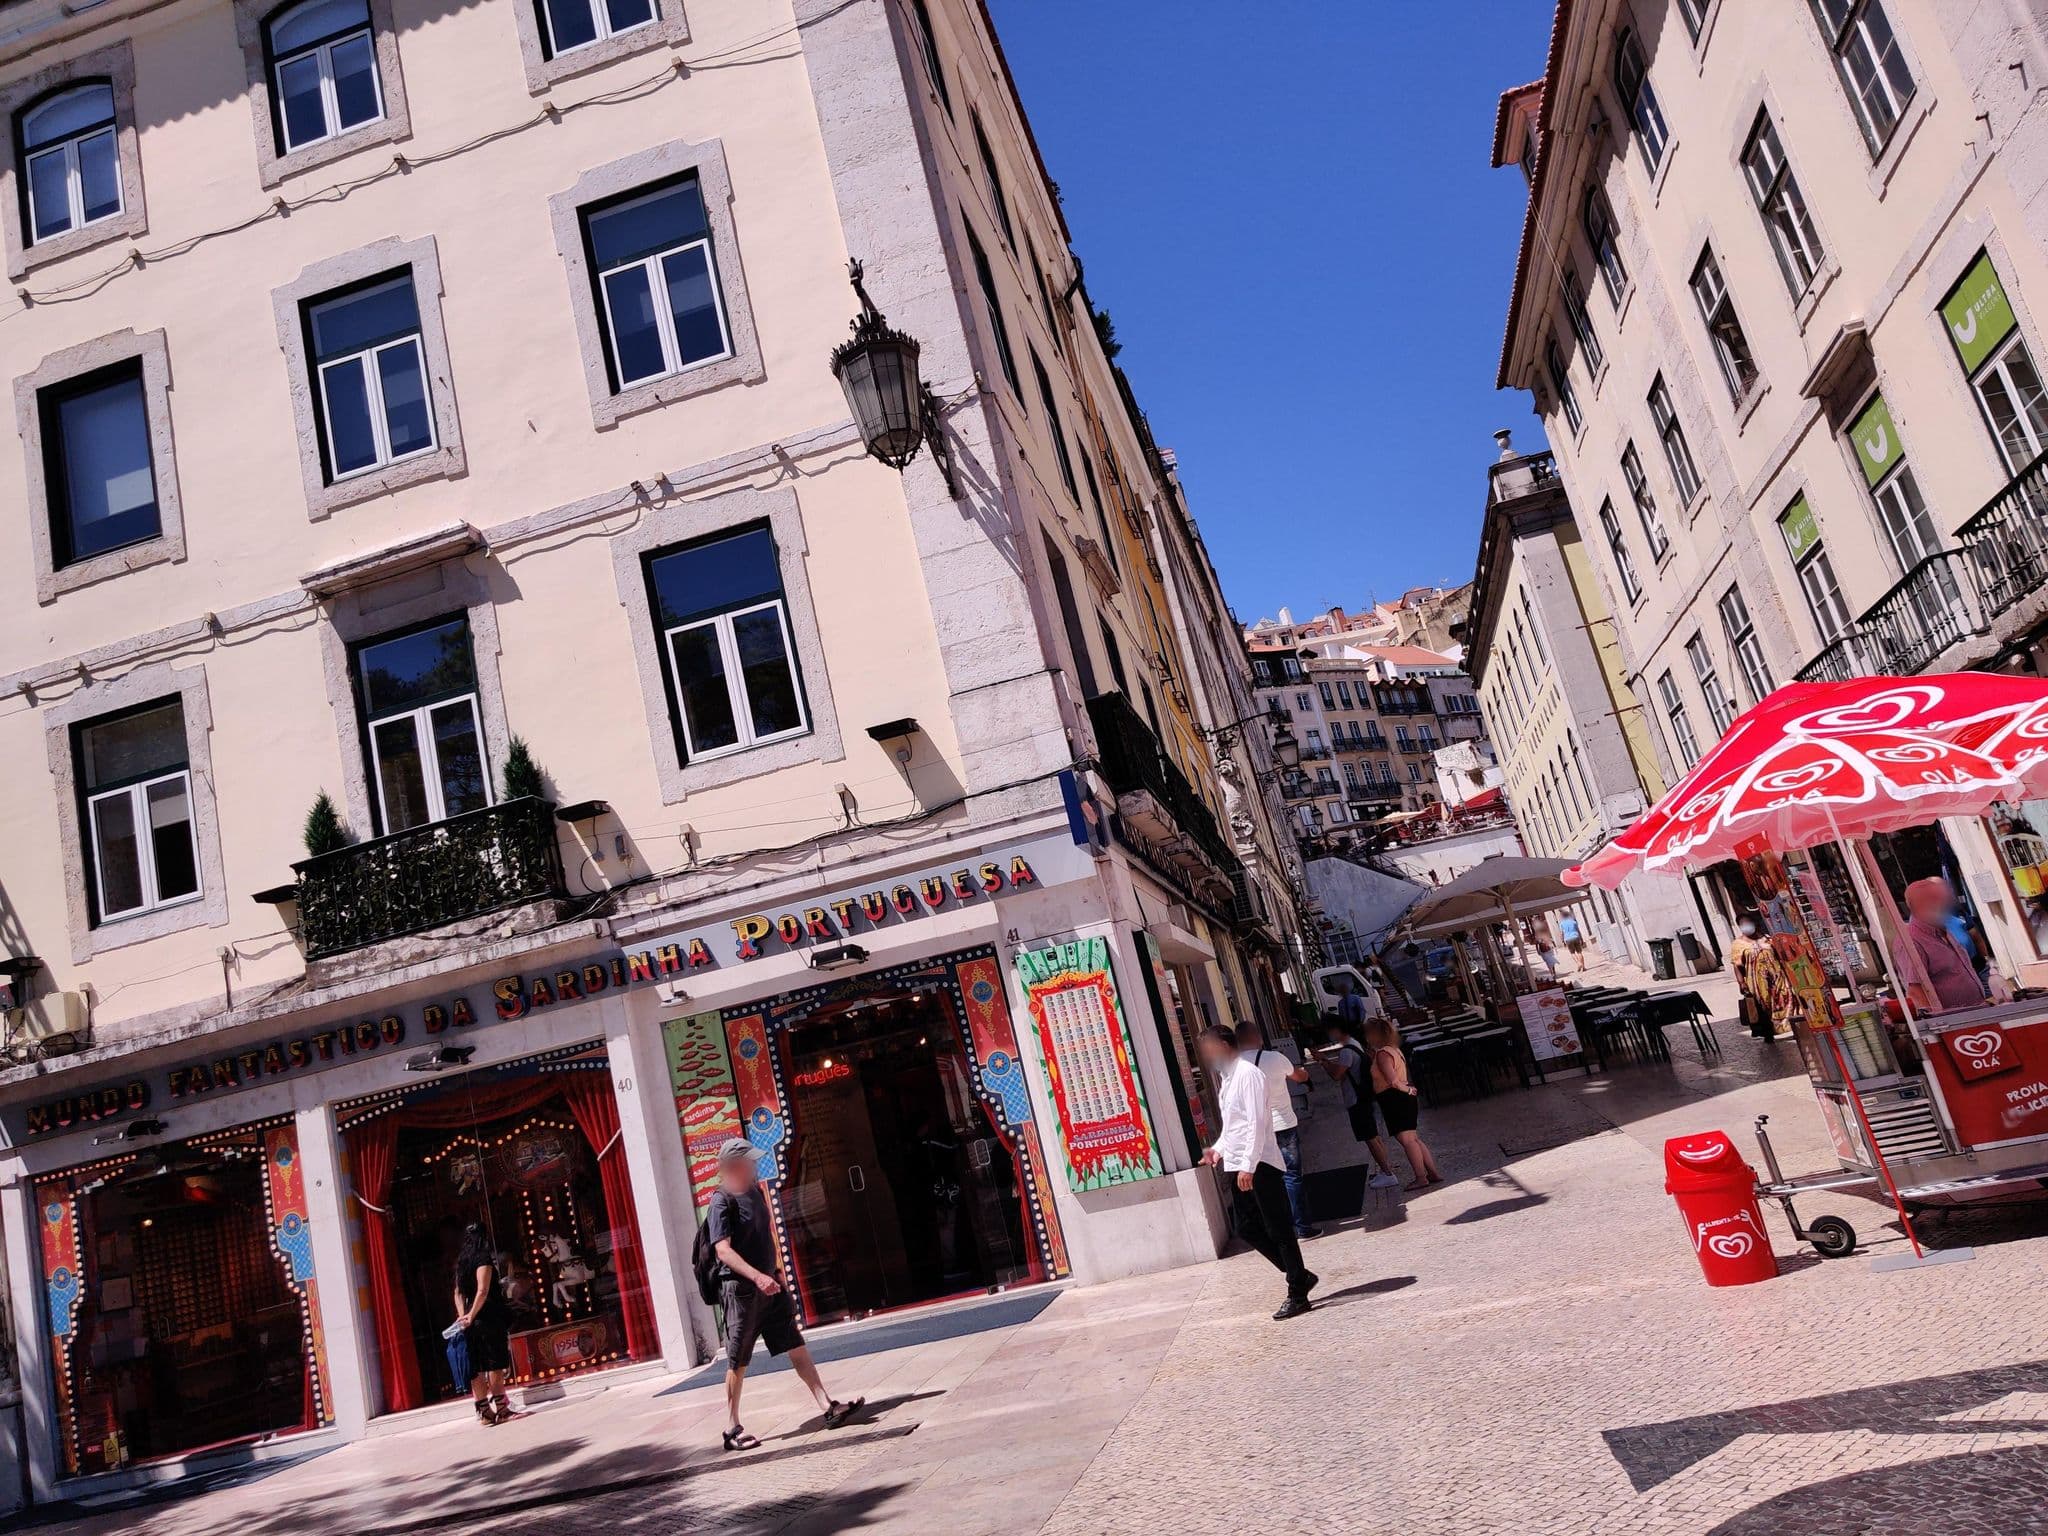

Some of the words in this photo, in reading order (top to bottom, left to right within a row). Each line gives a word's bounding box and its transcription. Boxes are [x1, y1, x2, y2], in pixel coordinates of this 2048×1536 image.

[1974, 283, 1997, 312] ULTRA
[1007, 927, 1021, 942] 41
[26, 1079, 147, 1136] MUNDO
[422, 997, 477, 1035] DA
[493, 937, 714, 1021] SARDINHA
[730, 854, 1035, 961] PORTUGUESA
[1972, 1054, 2001, 1070] OLÁ
[617, 1077, 632, 1092] 40
[2006, 1081, 2047, 1103] PROVA
[684, 1104, 716, 1123] sardinha
[1068, 1129, 1145, 1151] PORTUGUESA
[1073, 1123, 1137, 1143] SARDINHA
